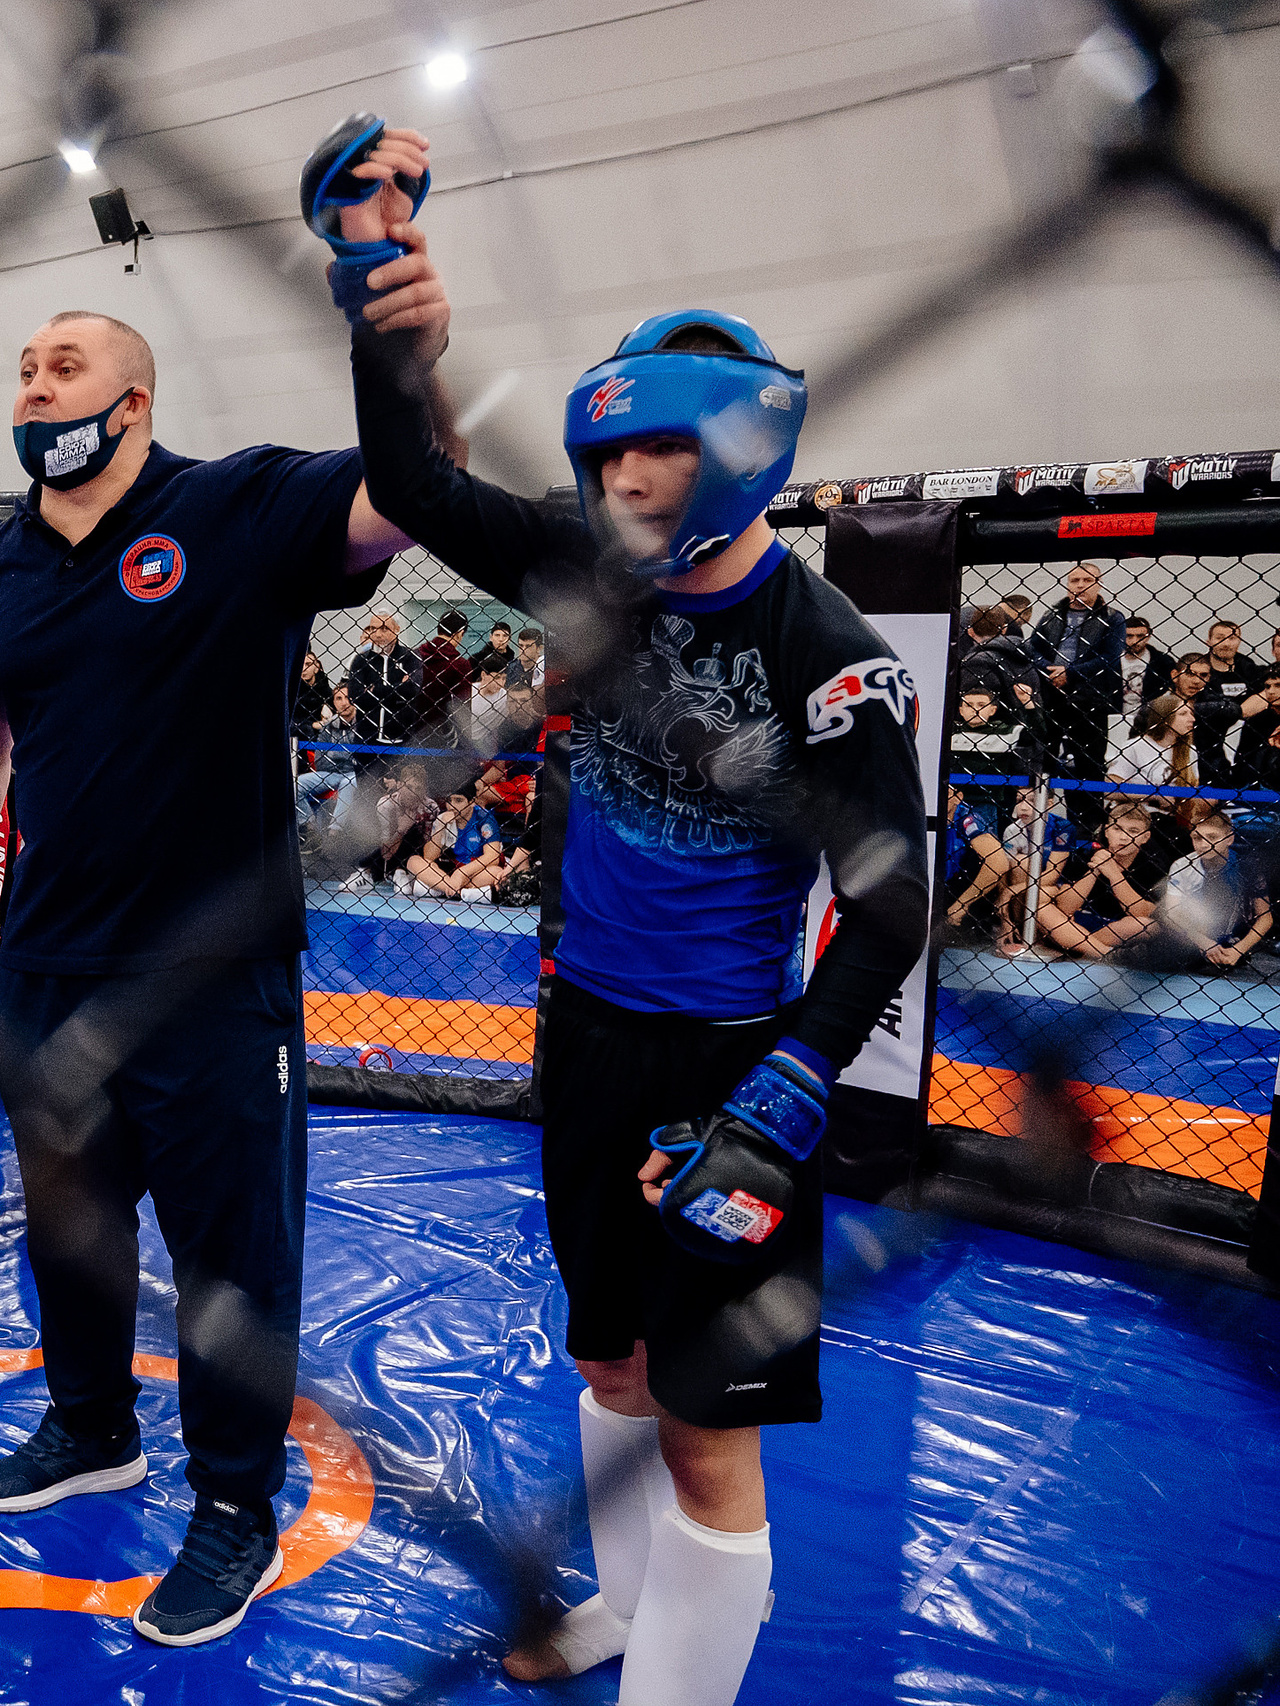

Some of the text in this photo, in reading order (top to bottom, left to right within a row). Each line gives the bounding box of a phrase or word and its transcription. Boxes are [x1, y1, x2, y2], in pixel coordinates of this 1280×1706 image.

[1191, 459, 1238, 473] MOTIV
[1035, 467, 1079, 480] MOTIV
[1191, 472, 1233, 482] WARRIORS
[871, 479, 909, 492] MOTIV
[929, 475, 993, 487] BAR LONDON
[1087, 518, 1147, 533] SPARTA
[276, 1045, 288, 1094] adidas
[735, 1382, 767, 1391] DEMIX
[214, 1501, 236, 1514] adidas
